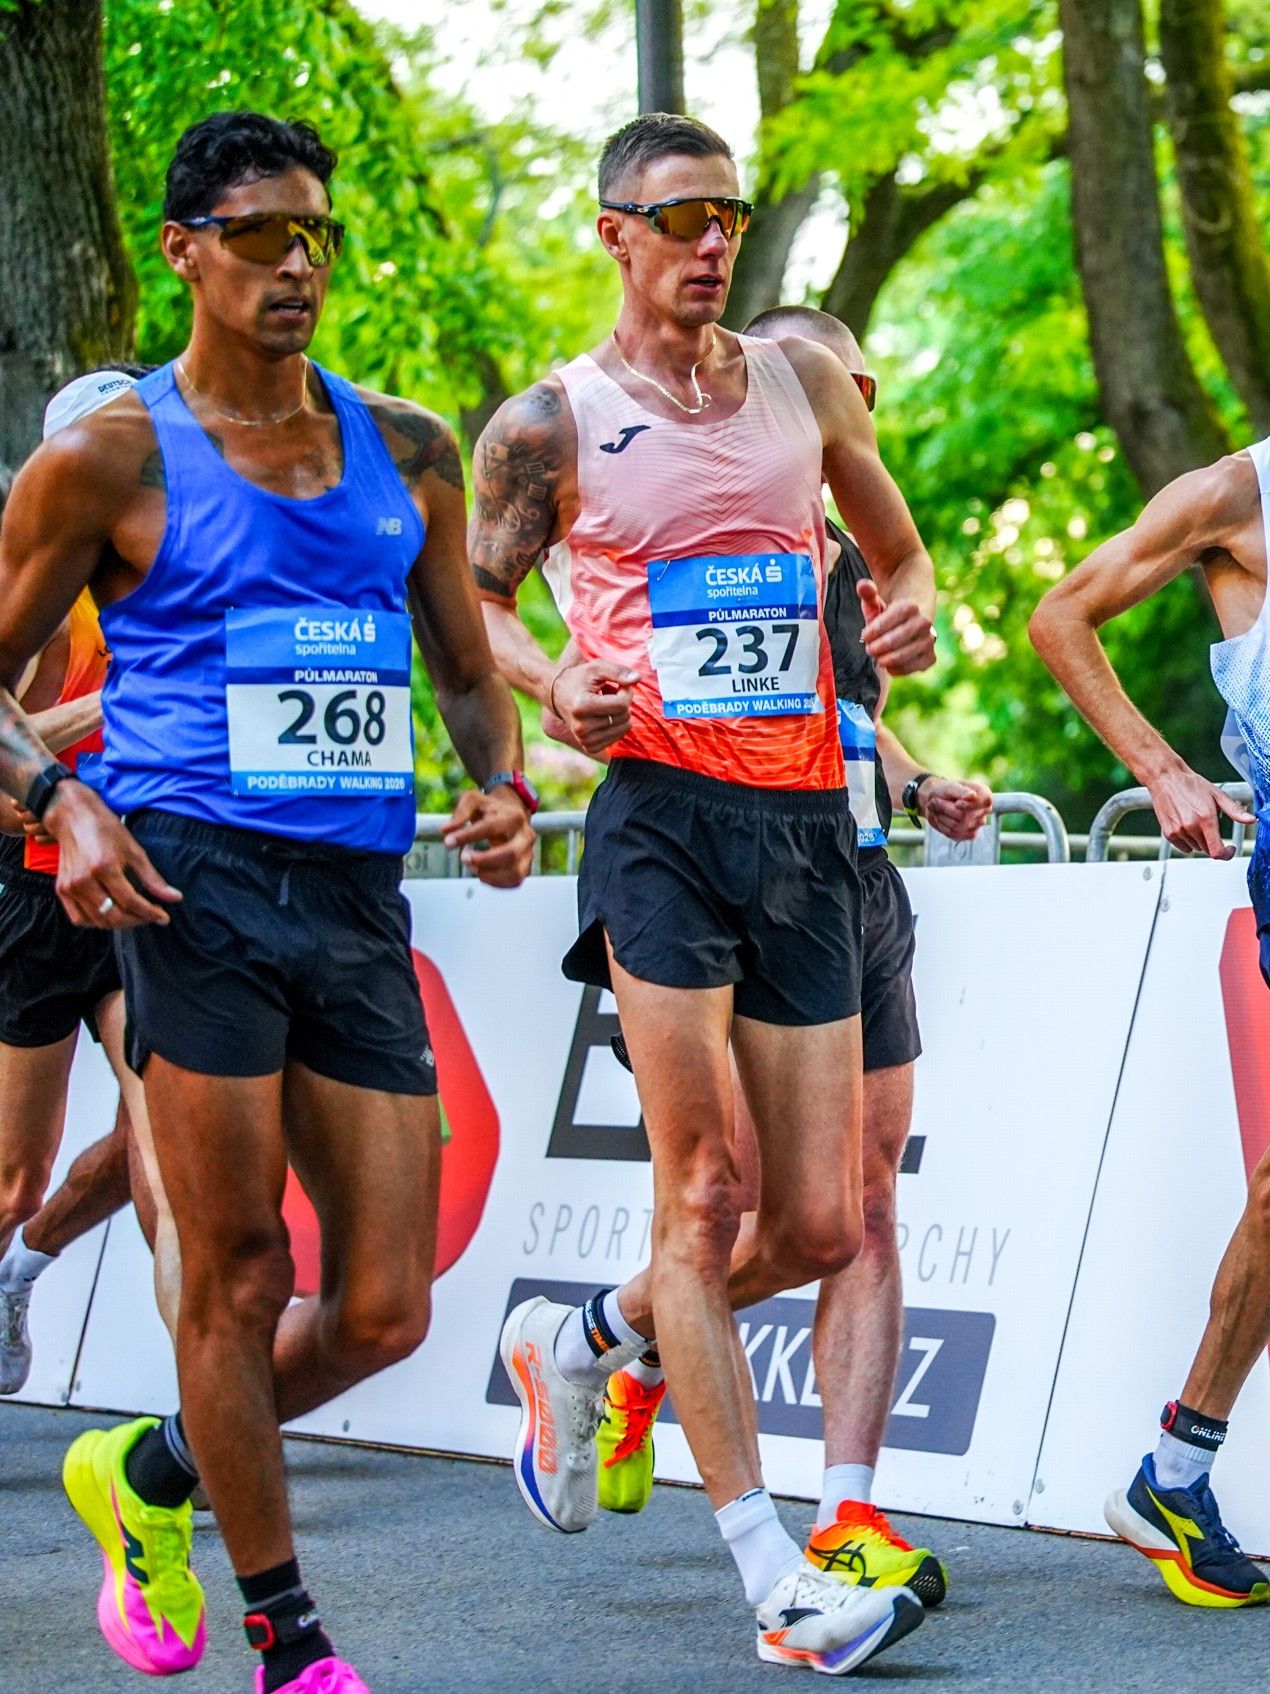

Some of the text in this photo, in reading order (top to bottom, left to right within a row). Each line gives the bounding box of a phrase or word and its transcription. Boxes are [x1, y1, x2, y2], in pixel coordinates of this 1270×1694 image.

[704, 563, 764, 586] ČESKÁ
[707, 585, 759, 599] spořitelna
[708, 606, 787, 622] PŮLMARATON
[294, 616, 362, 642] ČESKÁ
[294, 643, 357, 656] spořitelna
[695, 623, 800, 677] 237
[294, 668, 378, 684] PŮLMARATON
[732, 677, 780, 693] LINKE
[676, 700, 749, 715] PODĚBRADY
[752, 698, 801, 712] WALKING
[277, 689, 386, 746] 268
[307, 751, 372, 767] CHAMA
[247, 774, 406, 791] PODĚBRADY WALKING 2026
[522, 1201, 653, 1262] SPORT
